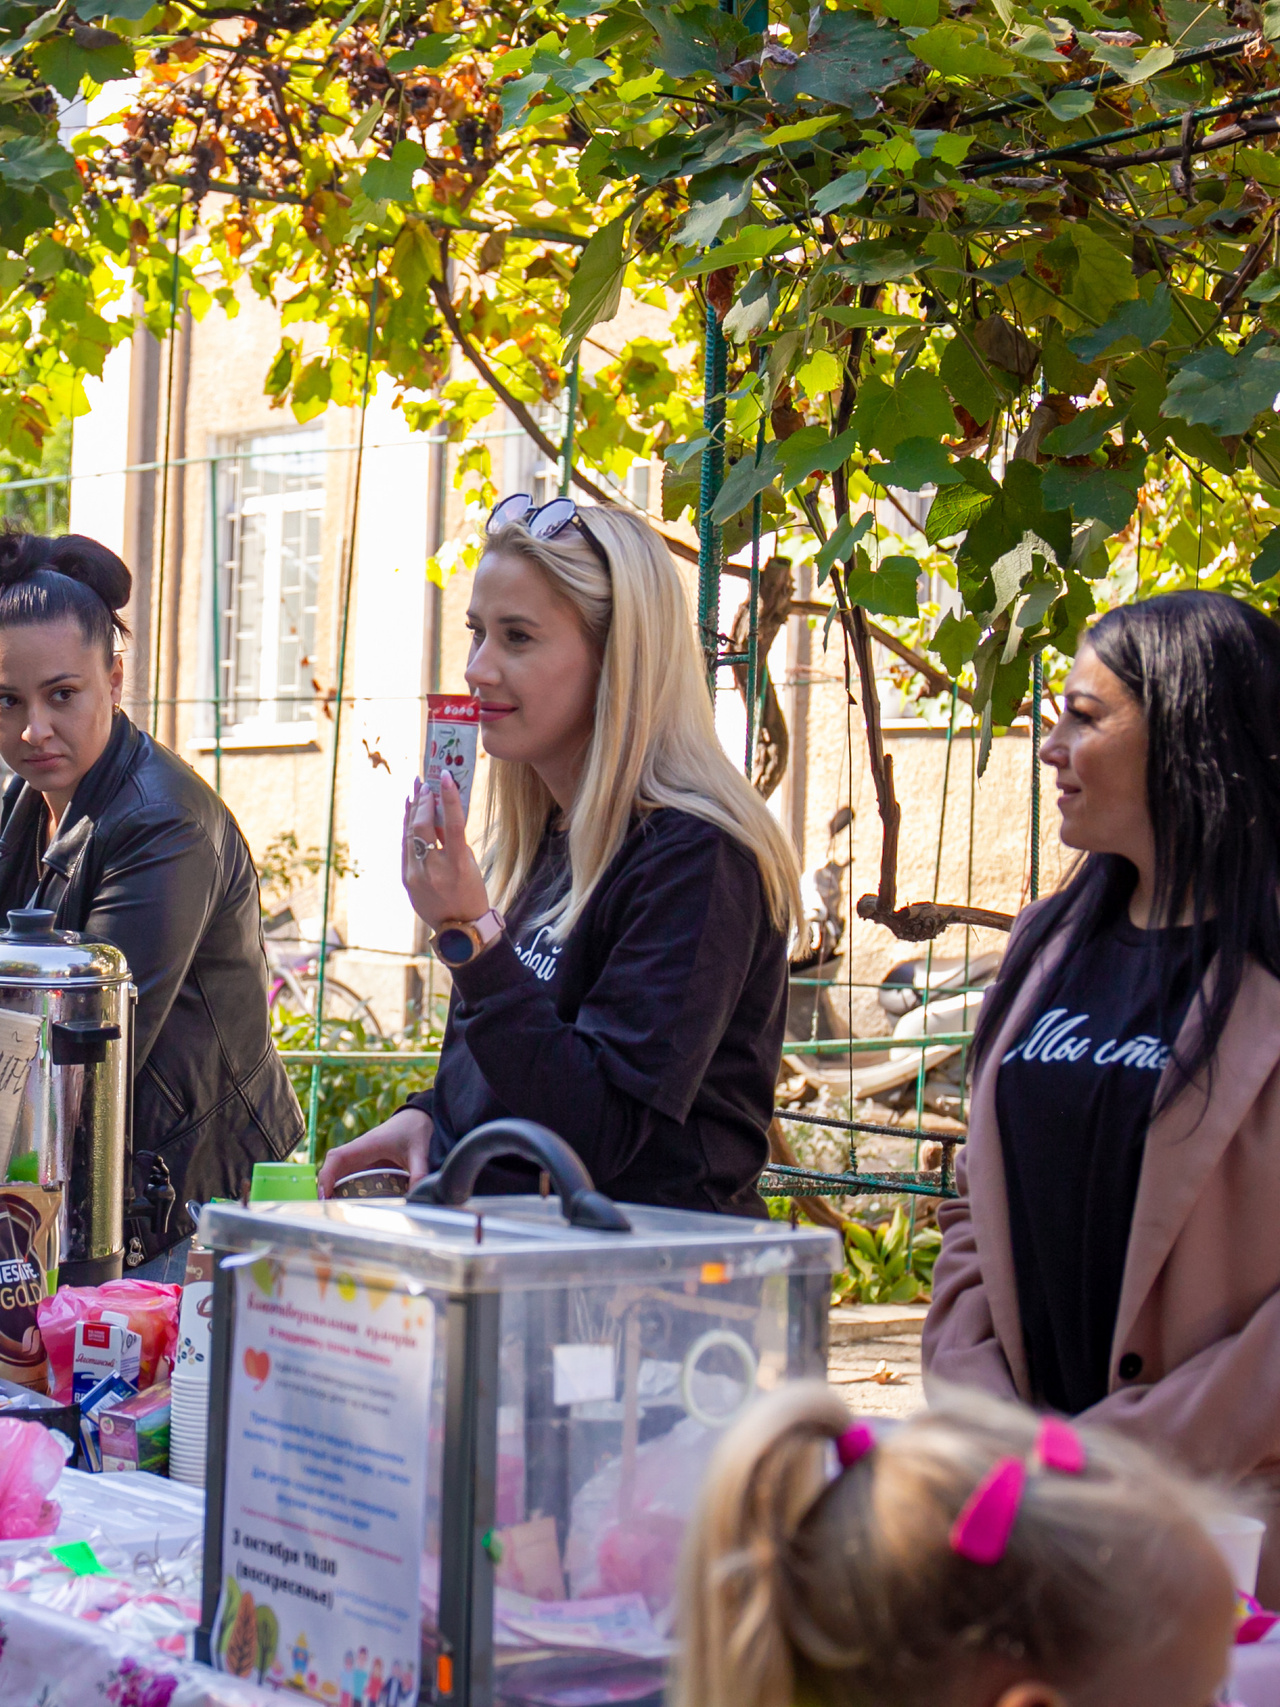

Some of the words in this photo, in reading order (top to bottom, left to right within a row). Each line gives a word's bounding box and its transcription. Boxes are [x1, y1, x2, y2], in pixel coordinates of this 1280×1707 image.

[1001, 1008, 1089, 1062] Мы
[0, 1283, 43, 1310] GOLD
[242, 1534, 300, 1566] октября
